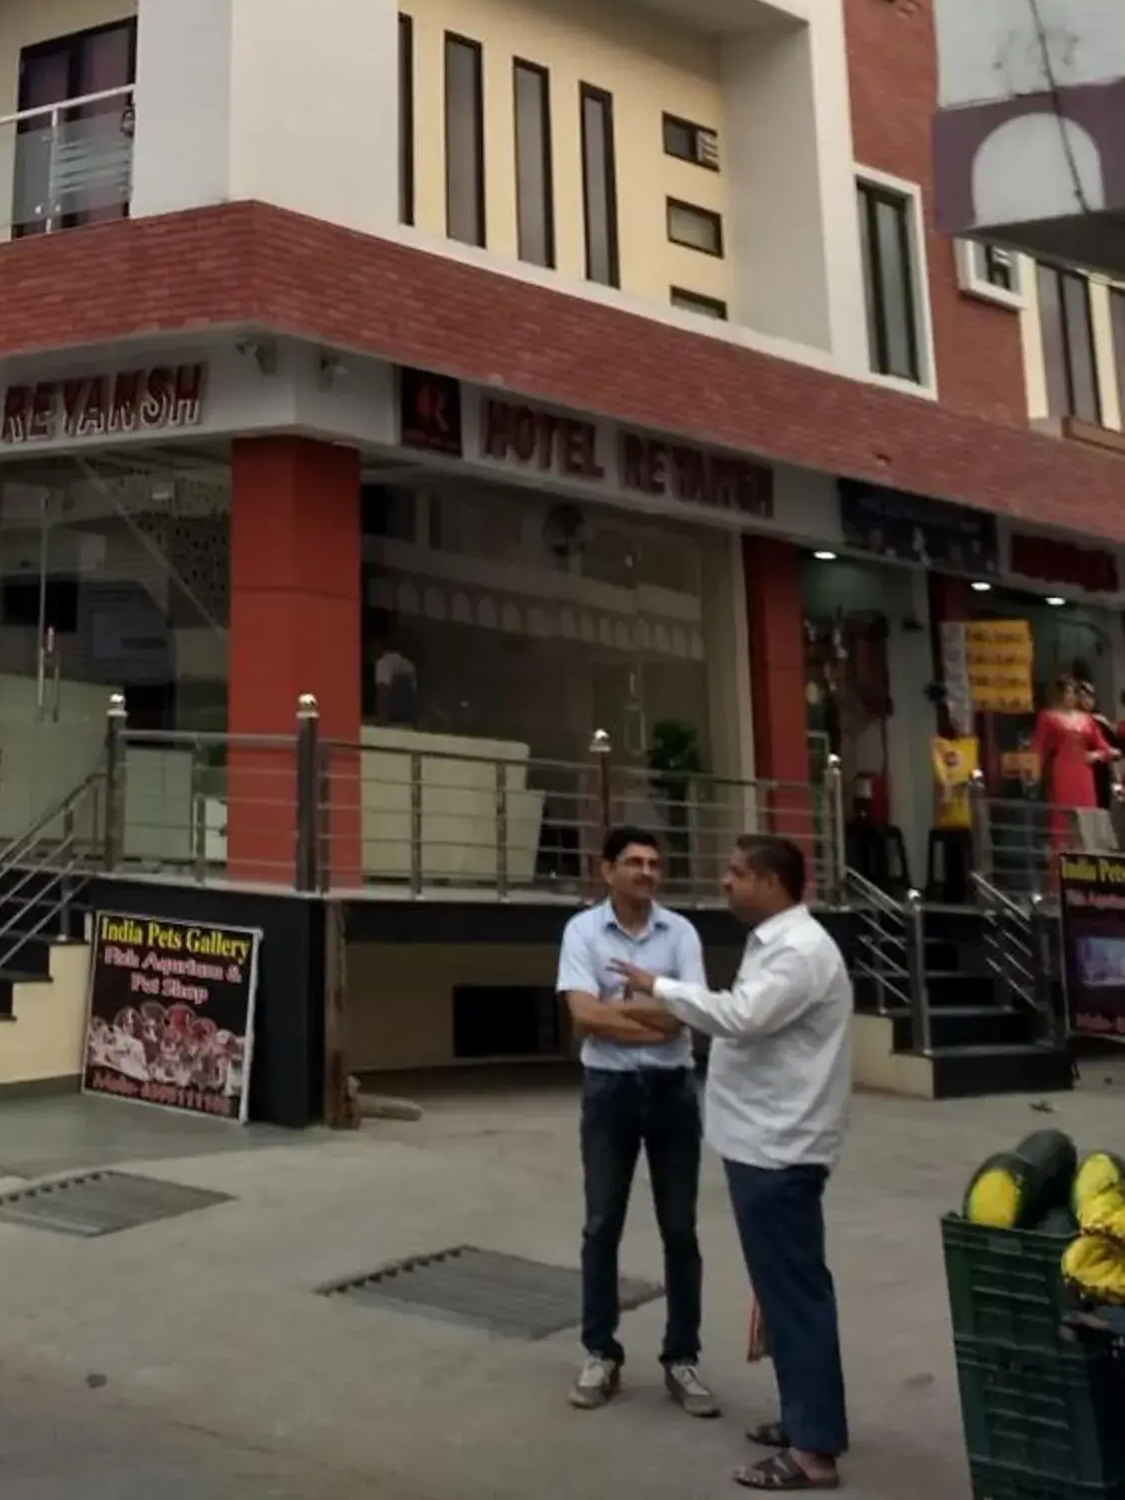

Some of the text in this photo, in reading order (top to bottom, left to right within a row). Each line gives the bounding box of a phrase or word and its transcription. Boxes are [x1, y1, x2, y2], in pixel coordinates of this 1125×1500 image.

[483, 398, 605, 479] HOTEL
[101, 916, 250, 965] India Pets Gallery
[104, 945, 140, 969] Fish
[225, 964, 243, 984] &
[131, 971, 209, 1005] Pet Shop
